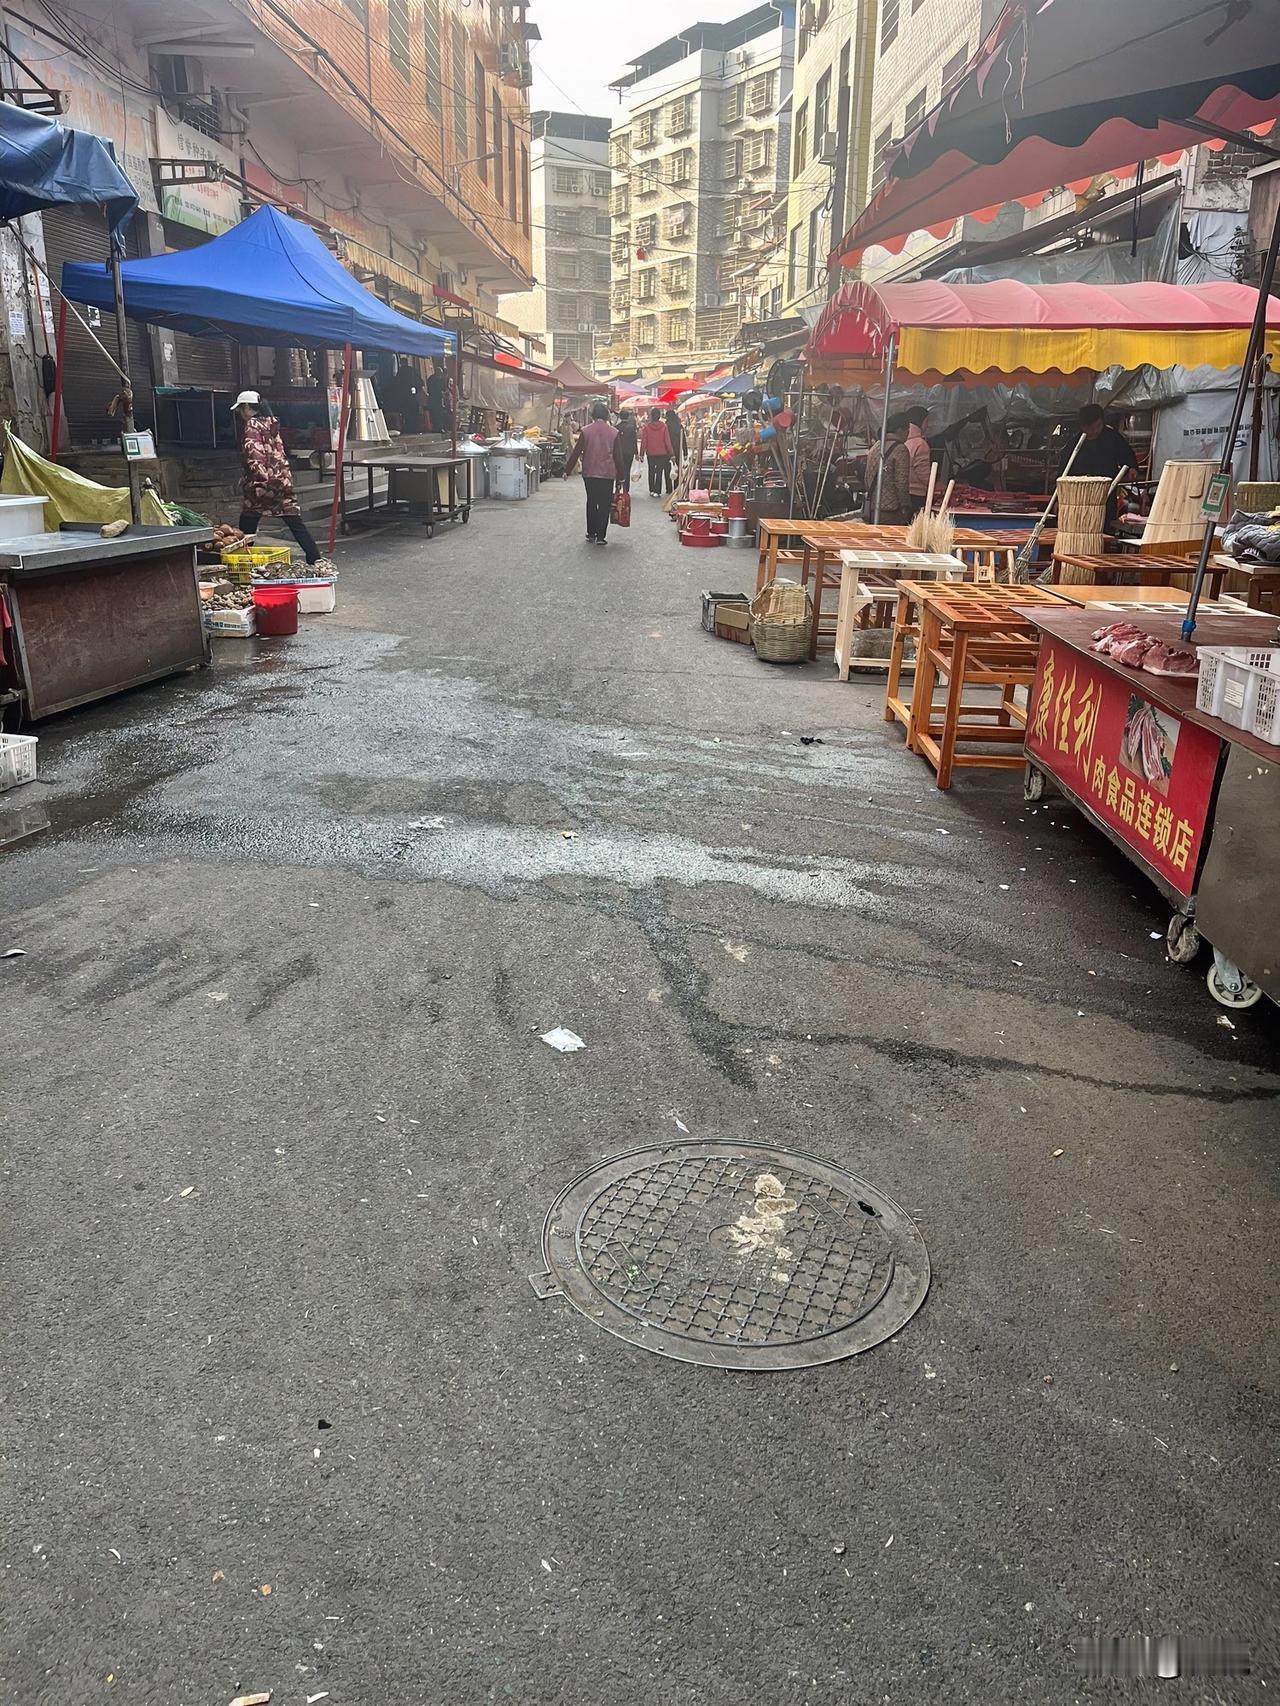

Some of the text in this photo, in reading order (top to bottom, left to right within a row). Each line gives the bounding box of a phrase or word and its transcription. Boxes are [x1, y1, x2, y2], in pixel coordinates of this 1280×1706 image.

[1091, 755, 1194, 872] 肉食品连锁店
